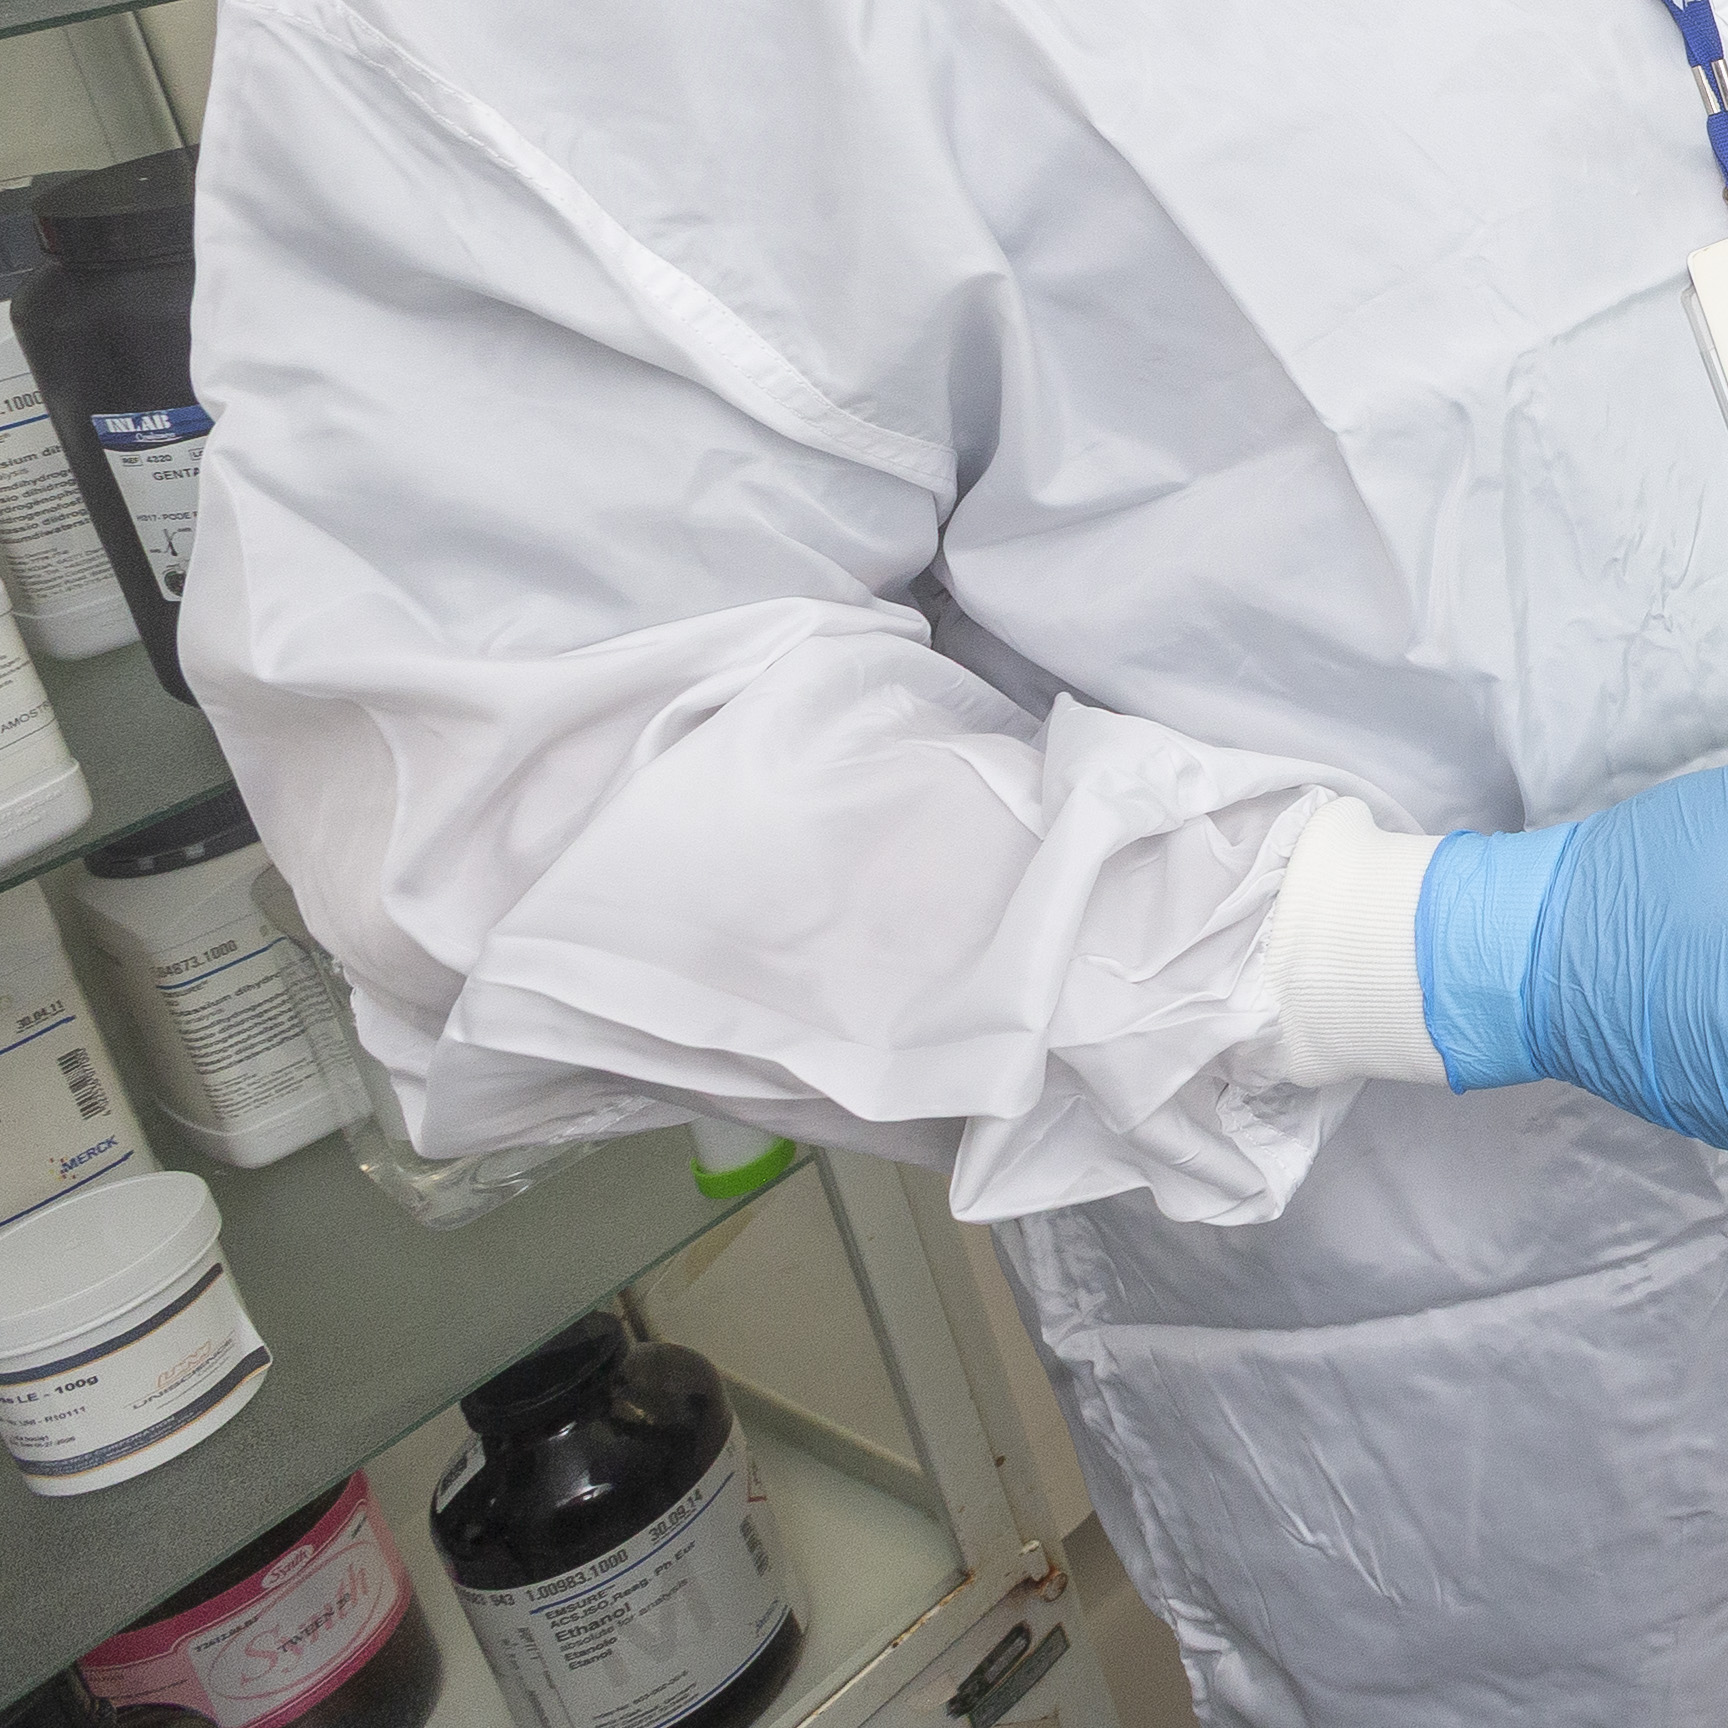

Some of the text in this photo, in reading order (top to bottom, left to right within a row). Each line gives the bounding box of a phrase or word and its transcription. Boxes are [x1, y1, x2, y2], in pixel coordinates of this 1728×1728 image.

[105, 416, 171, 433] INLAB
[121, 456, 142, 465] REF
[60, 1135, 119, 1174] MERCK
[17, 1391, 39, 1404] LE
[54, 1374, 99, 1394] 100g
[277, 1608, 335, 1653] TWEEN
[555, 1602, 632, 1643] Ethanol
[569, 1649, 613, 1670] Etanol
